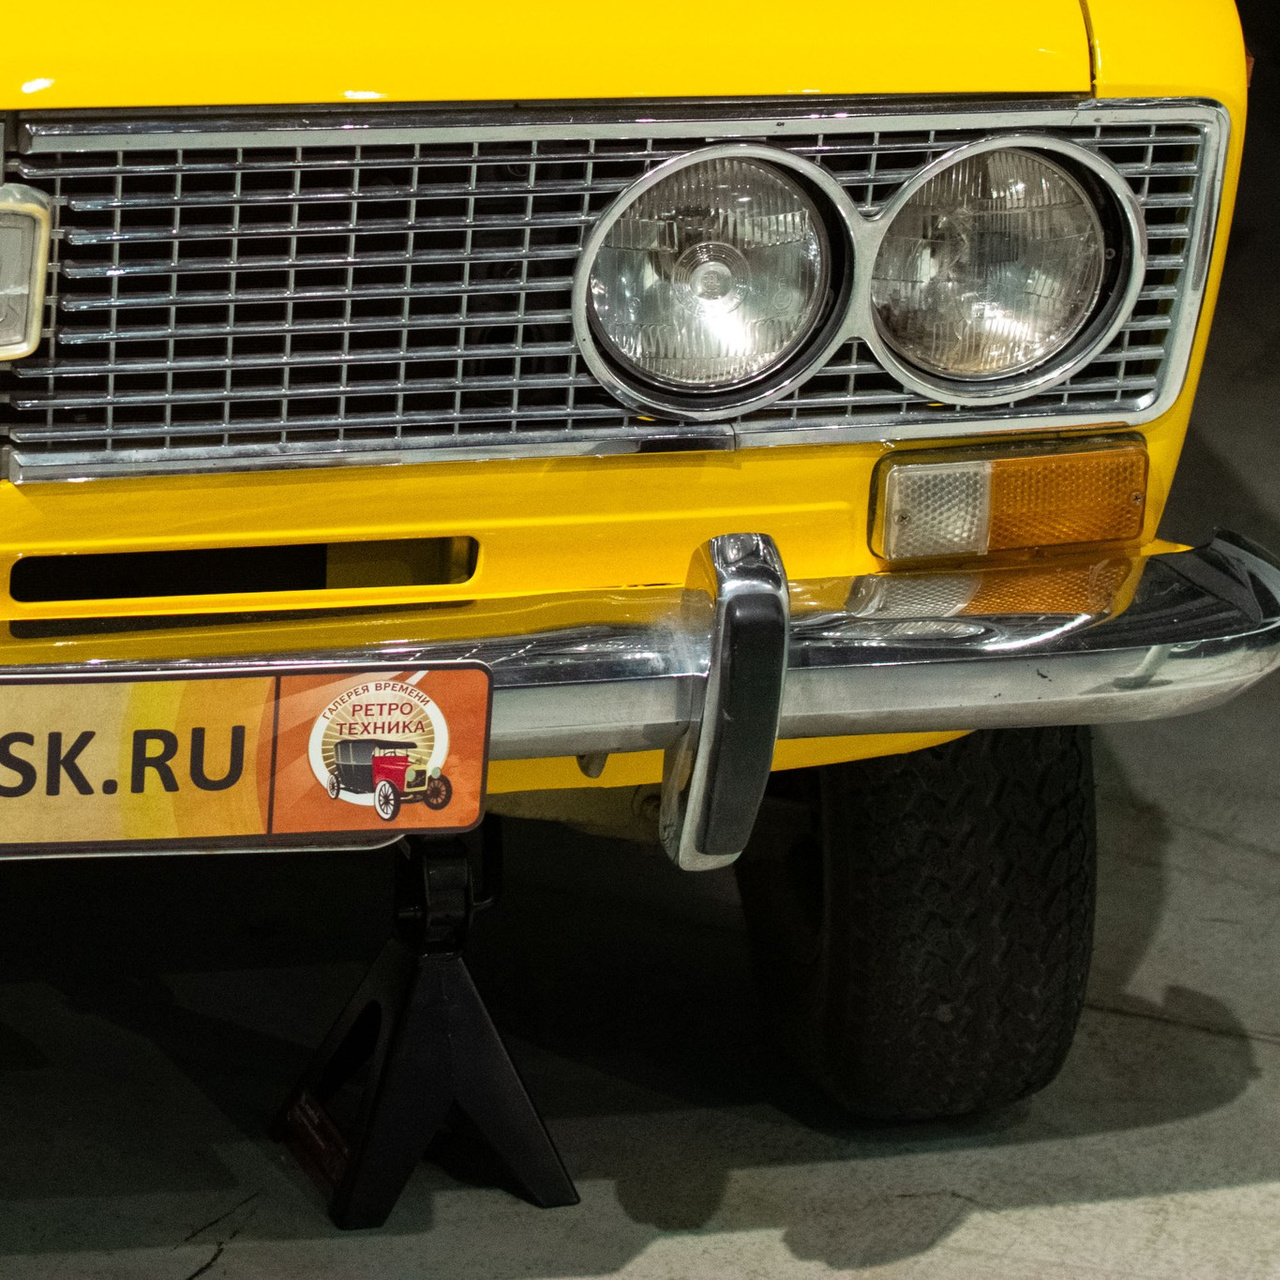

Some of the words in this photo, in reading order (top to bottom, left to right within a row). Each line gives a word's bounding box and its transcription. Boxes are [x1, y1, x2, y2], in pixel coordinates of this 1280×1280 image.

[323, 685, 370, 720] ГАЛЕРЕЯ
[375, 683, 431, 706] ВРЕМЕНИ
[351, 702, 413, 717] РЕТРО
[336, 720, 425, 736] ТЕХНИКА
